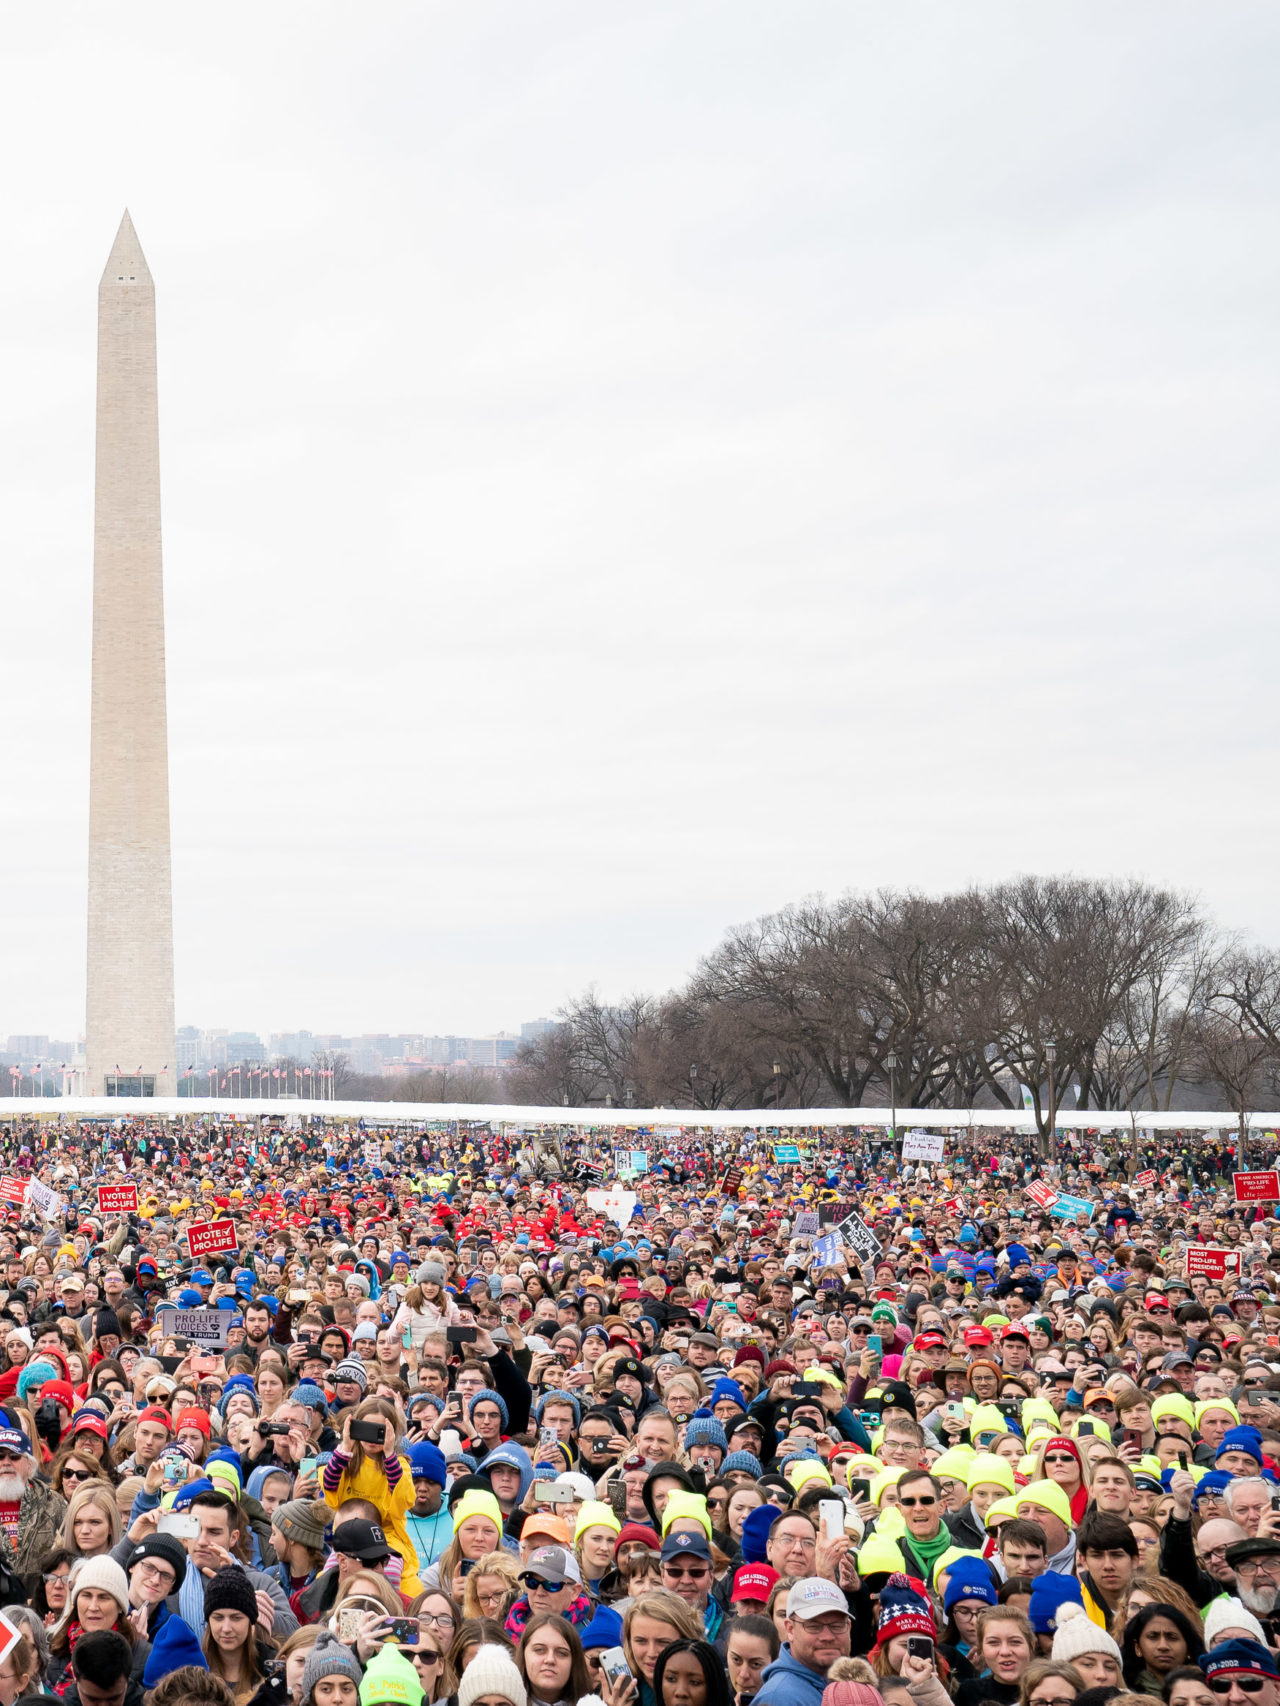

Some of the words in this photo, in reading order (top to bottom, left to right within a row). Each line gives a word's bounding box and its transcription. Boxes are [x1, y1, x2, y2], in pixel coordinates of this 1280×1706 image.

[106, 1192, 126, 1200] VOTE
[103, 1200, 135, 1208] PRO-LIFE
[824, 1204, 851, 1213] THIS
[832, 1213, 843, 1222] IS
[197, 1229, 222, 1241] VOTE
[845, 1219, 874, 1256] PRO-LIFE
[858, 1225, 874, 1246] VOTE
[194, 1236, 233, 1252] PRO-LIFE
[846, 1230, 864, 1252] FIRST
[1190, 1264, 1224, 1272] PRESIDENT.
[175, 1314, 220, 1323] PRO-LIFE
[175, 1322, 208, 1331] VOICES
[750, 1574, 770, 1582] AMERICA
[896, 1618, 912, 1627] MAKE
[1220, 1660, 1239, 1668] 2002
